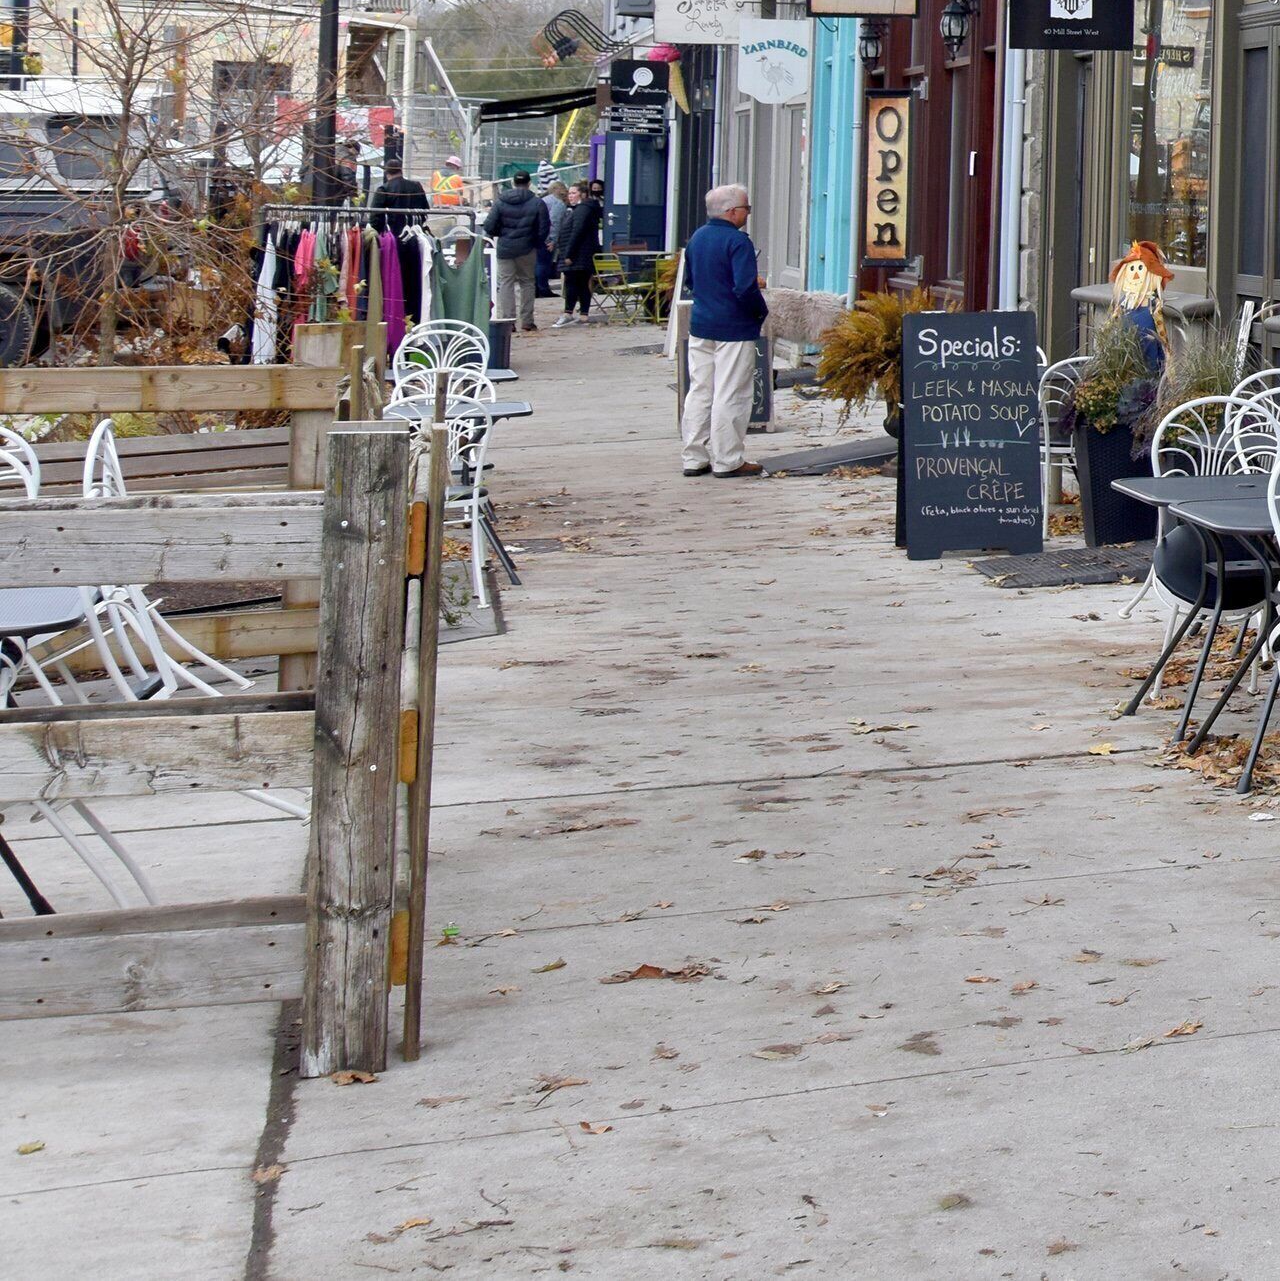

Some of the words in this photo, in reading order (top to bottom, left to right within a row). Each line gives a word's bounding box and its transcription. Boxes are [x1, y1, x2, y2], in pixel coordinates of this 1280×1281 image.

[1083, 28, 1100, 36] West
[741, 38, 809, 58] YARNBIRD
[872, 105, 902, 247] Open
[917, 325, 1021, 368] Specials:
[911, 379, 964, 400] LEEK
[980, 379, 1037, 398] MASALA
[922, 403, 982, 422] POTATO
[989, 403, 1030, 422] SOUP
[916, 456, 1011, 481] PROVENÇAL
[966, 480, 1025, 503] CRÊPE
[950, 504, 971, 515] black
[973, 504, 996, 514] olives
[1005, 505, 1021, 514] sun
[1022, 504, 1040, 514] dried
